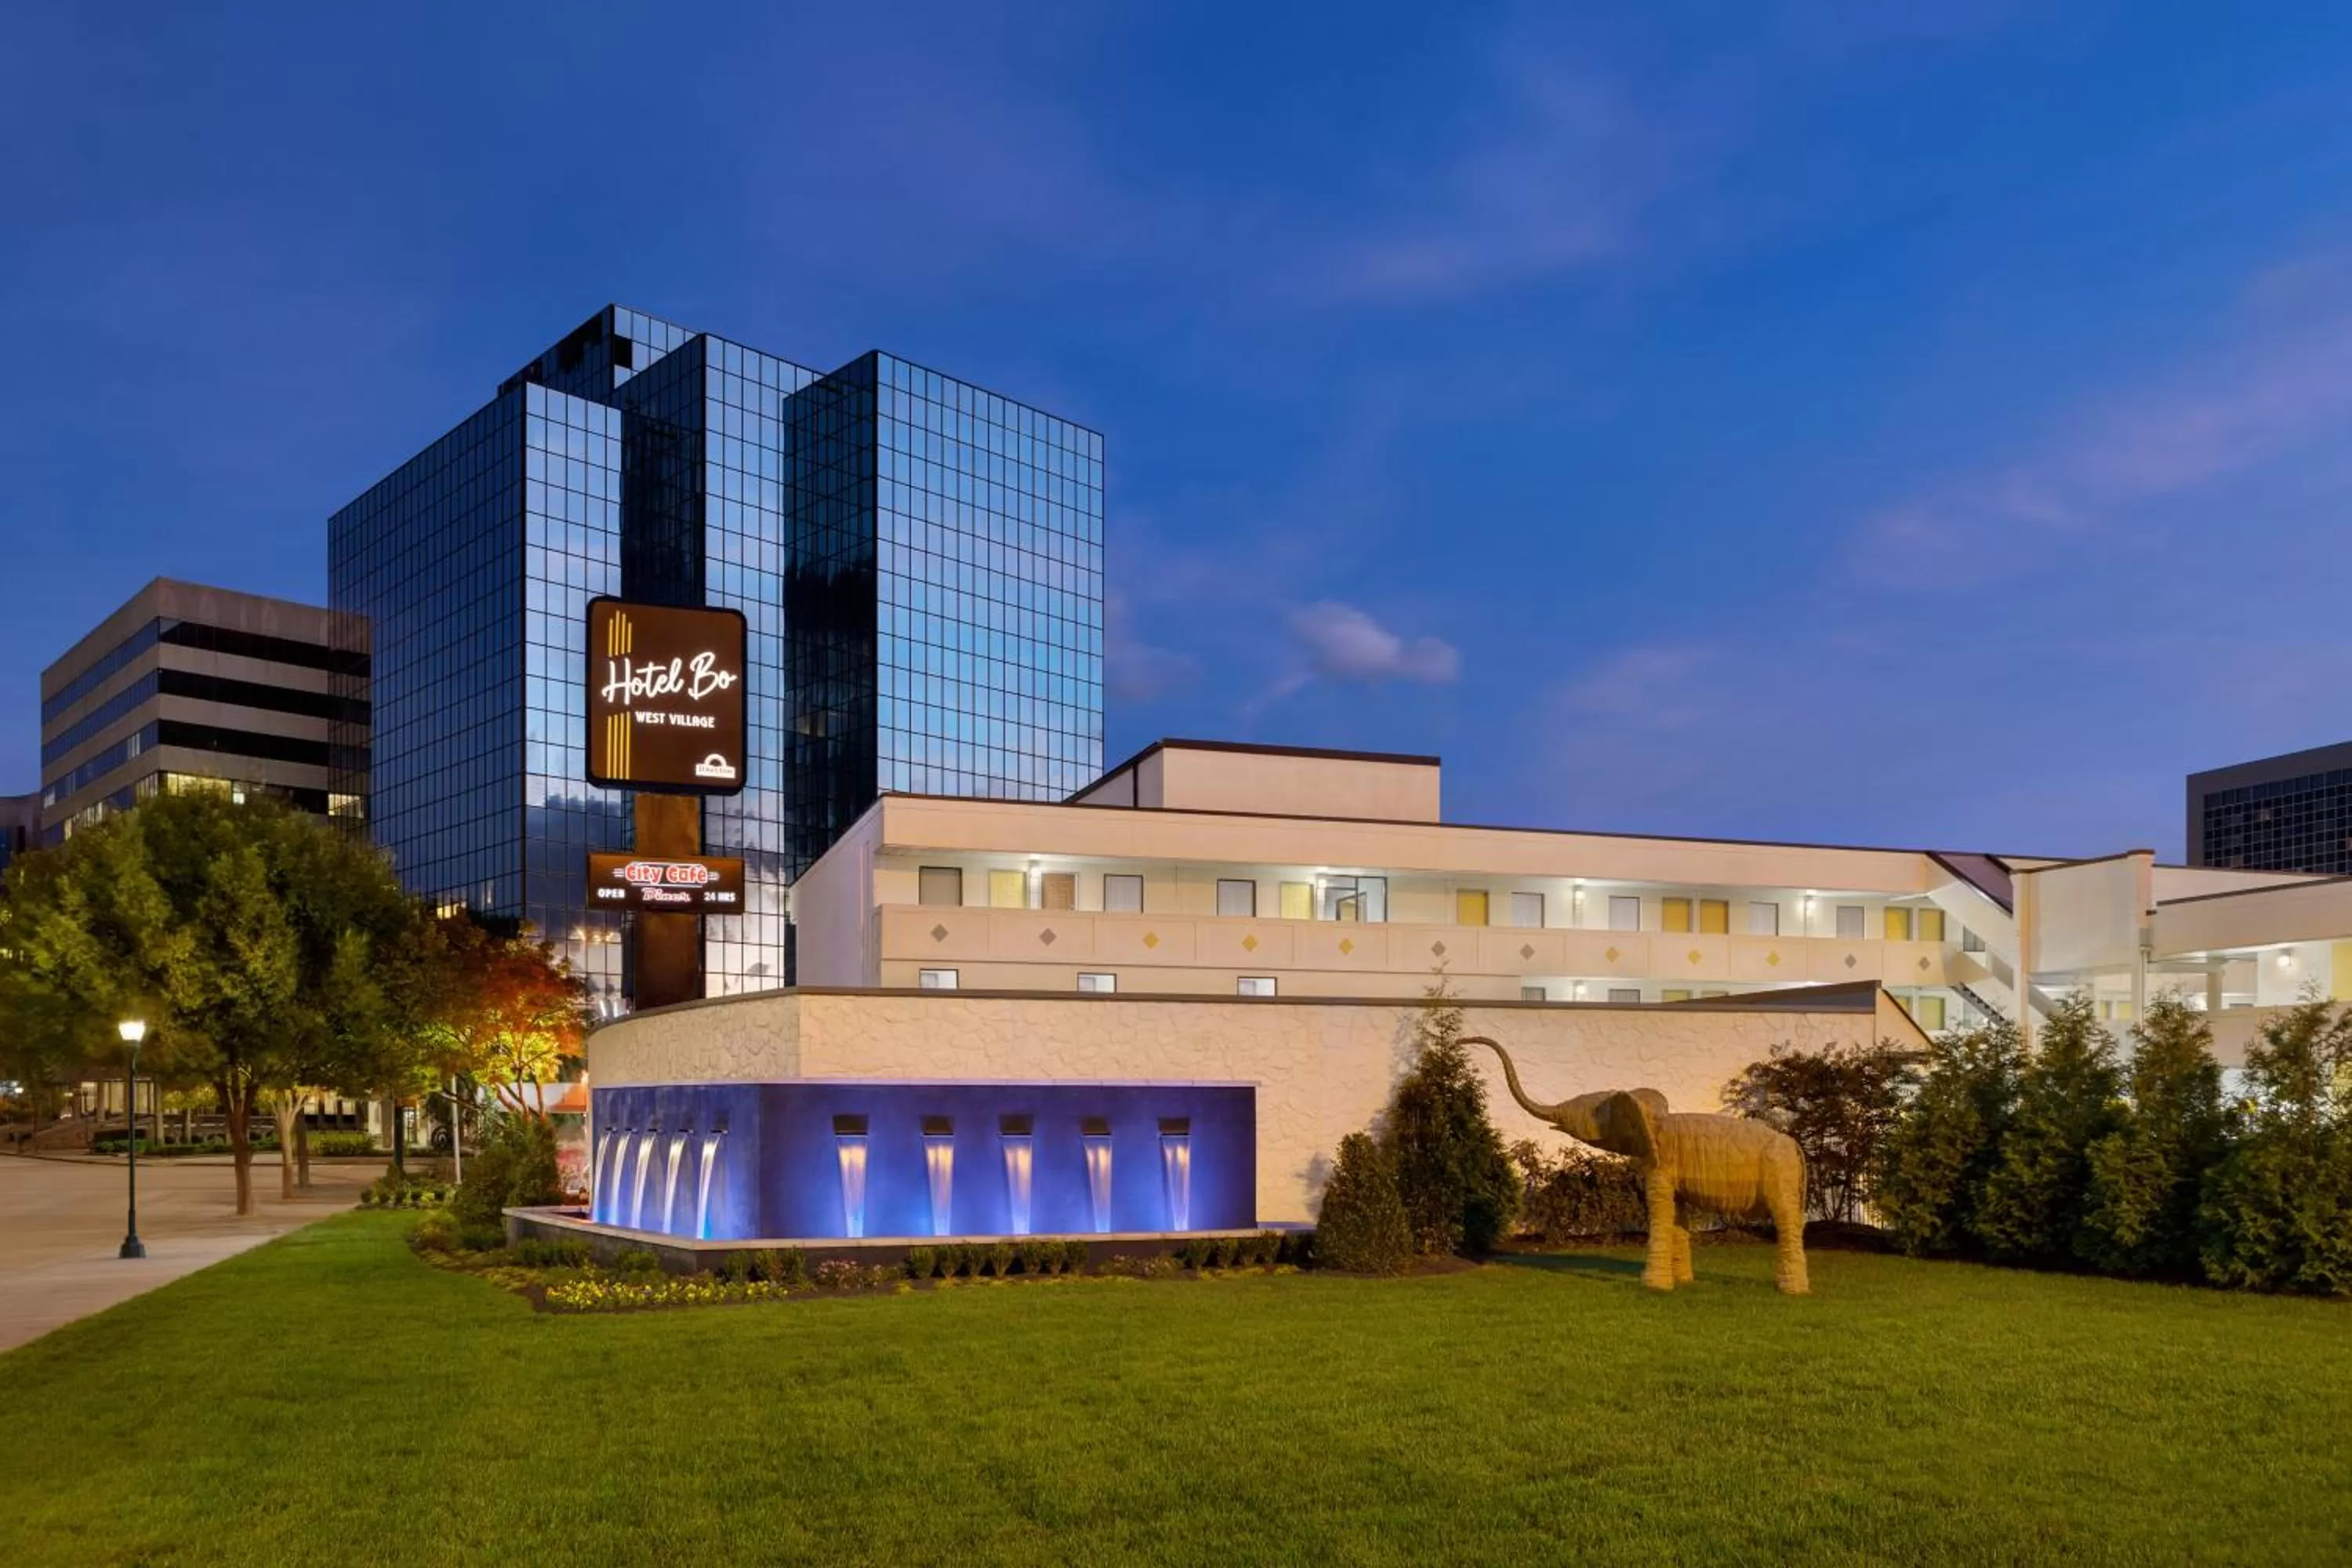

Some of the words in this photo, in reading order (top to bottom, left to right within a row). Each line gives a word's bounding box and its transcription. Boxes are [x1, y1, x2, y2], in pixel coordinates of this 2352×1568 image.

[601, 657, 684, 706] Hotel
[688, 652, 738, 700] Bo
[635, 710, 666, 724] WEST
[669, 712, 715, 728] VILLAGE
[625, 863, 663, 885] City
[597, 888, 626, 899] OPEN
[704, 891, 716, 901] 24
[717, 892, 736, 902] HRS
